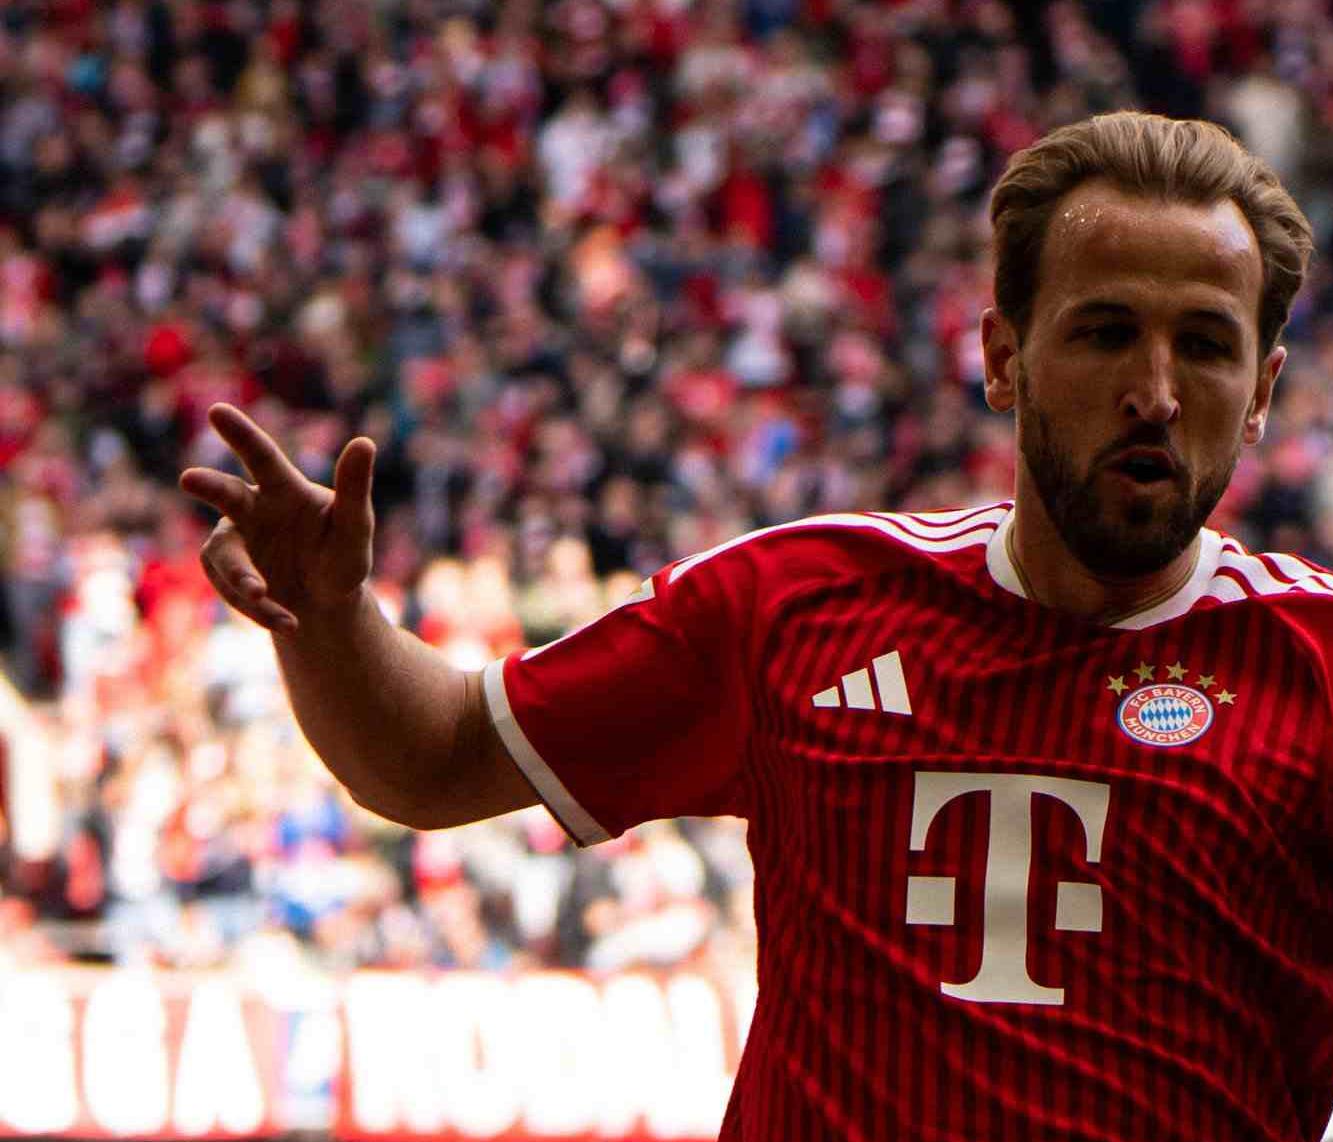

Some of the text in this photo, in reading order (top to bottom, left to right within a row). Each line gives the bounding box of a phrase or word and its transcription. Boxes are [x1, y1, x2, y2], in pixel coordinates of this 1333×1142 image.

[1129, 688, 1207, 714] FC BAYERN
[905, 771, 1111, 1006] T
